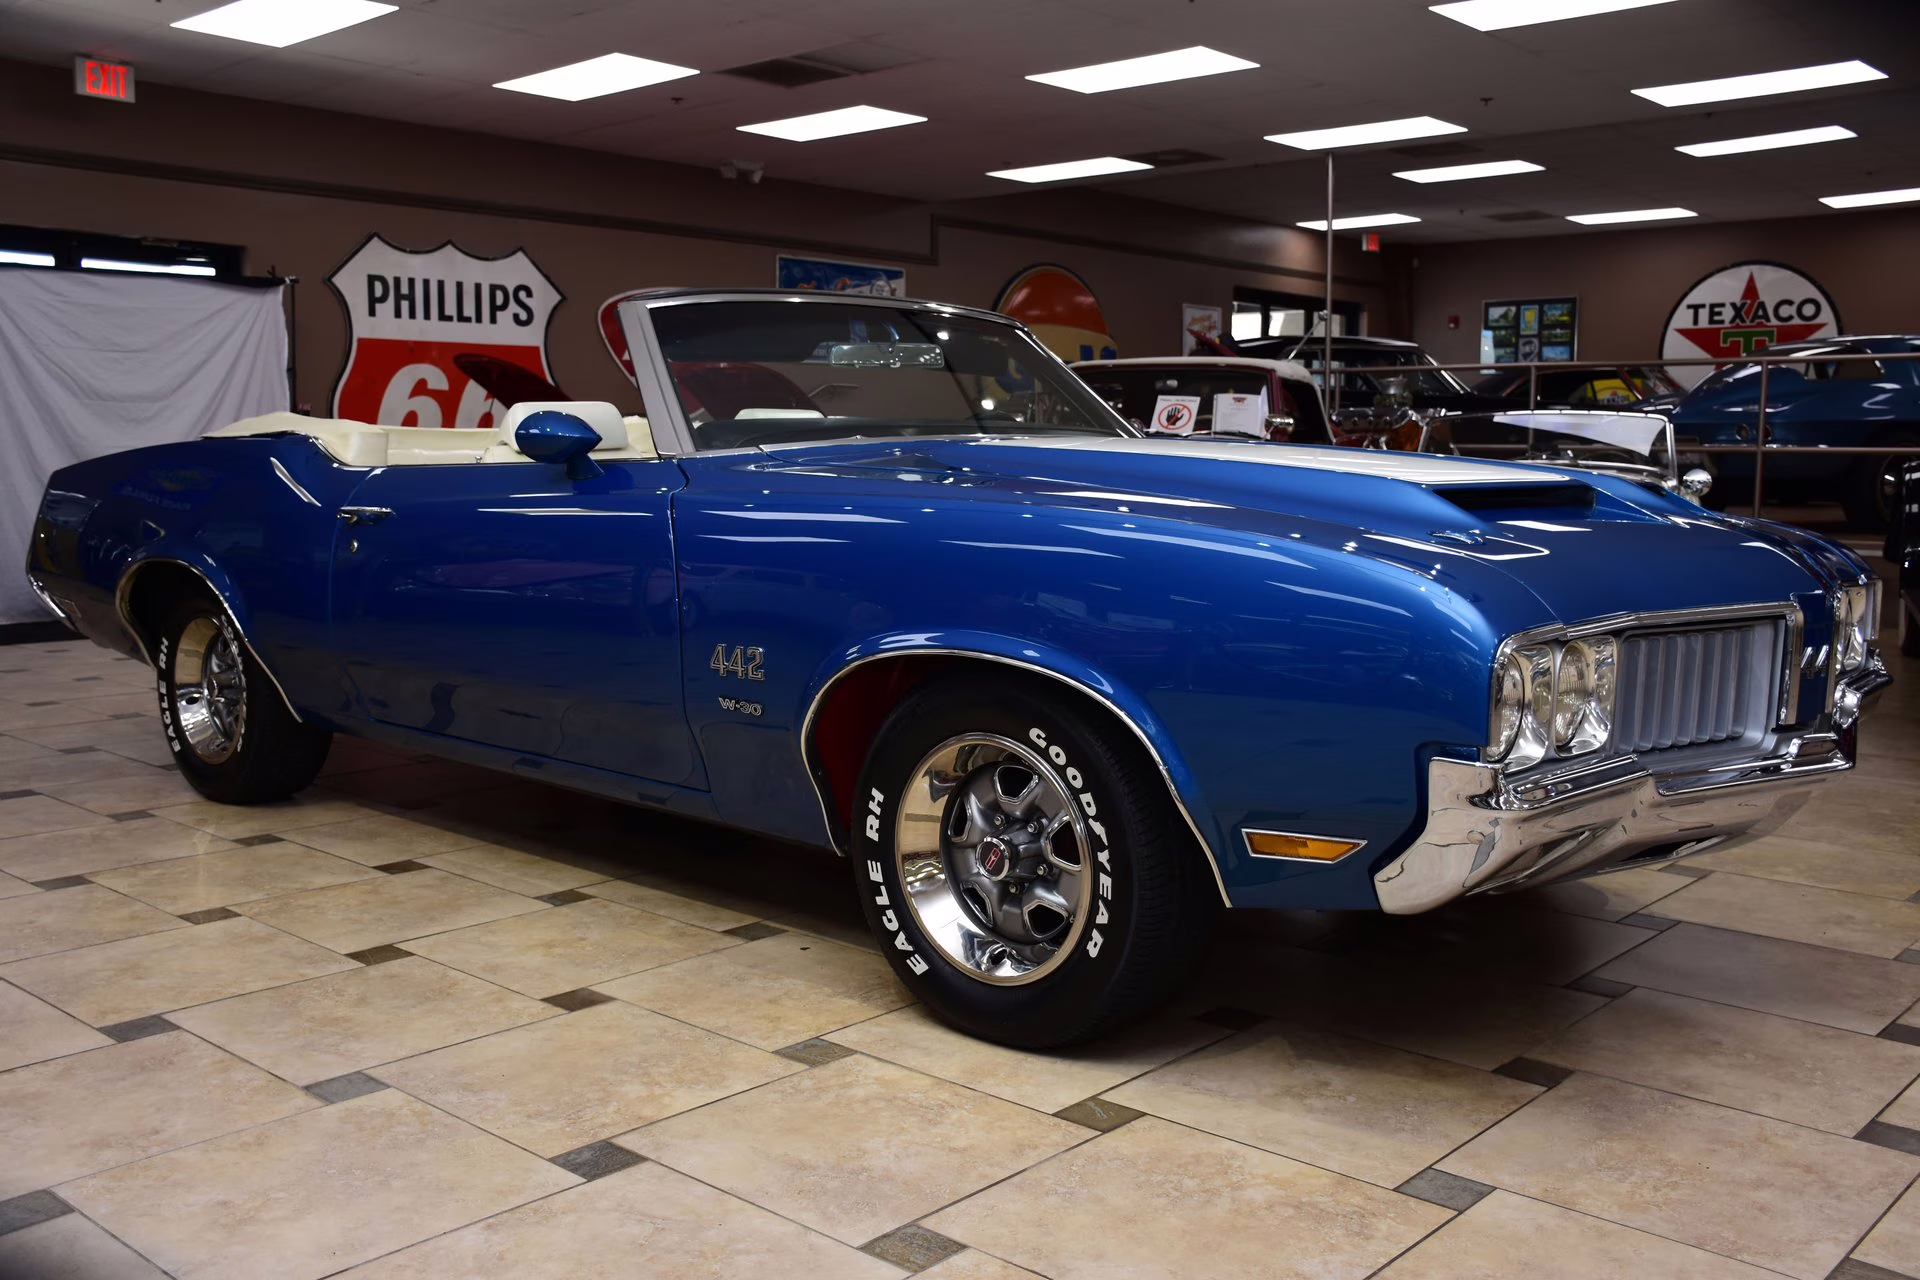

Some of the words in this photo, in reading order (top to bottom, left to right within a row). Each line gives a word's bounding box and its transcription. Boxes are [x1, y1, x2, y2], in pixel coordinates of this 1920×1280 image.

[86, 61, 129, 98] EXIT
[366, 273, 535, 327] PHILLIPS
[1686, 298, 1822, 326] TEXACO
[158, 636, 170, 670] RH
[710, 644, 765, 680] 442
[158, 679, 181, 753] EAGLE
[718, 696, 762, 716] W-30
[865, 787, 885, 843] RH
[1028, 727, 1112, 958] GOODYEAR
[867, 859, 930, 976] EAGLE
